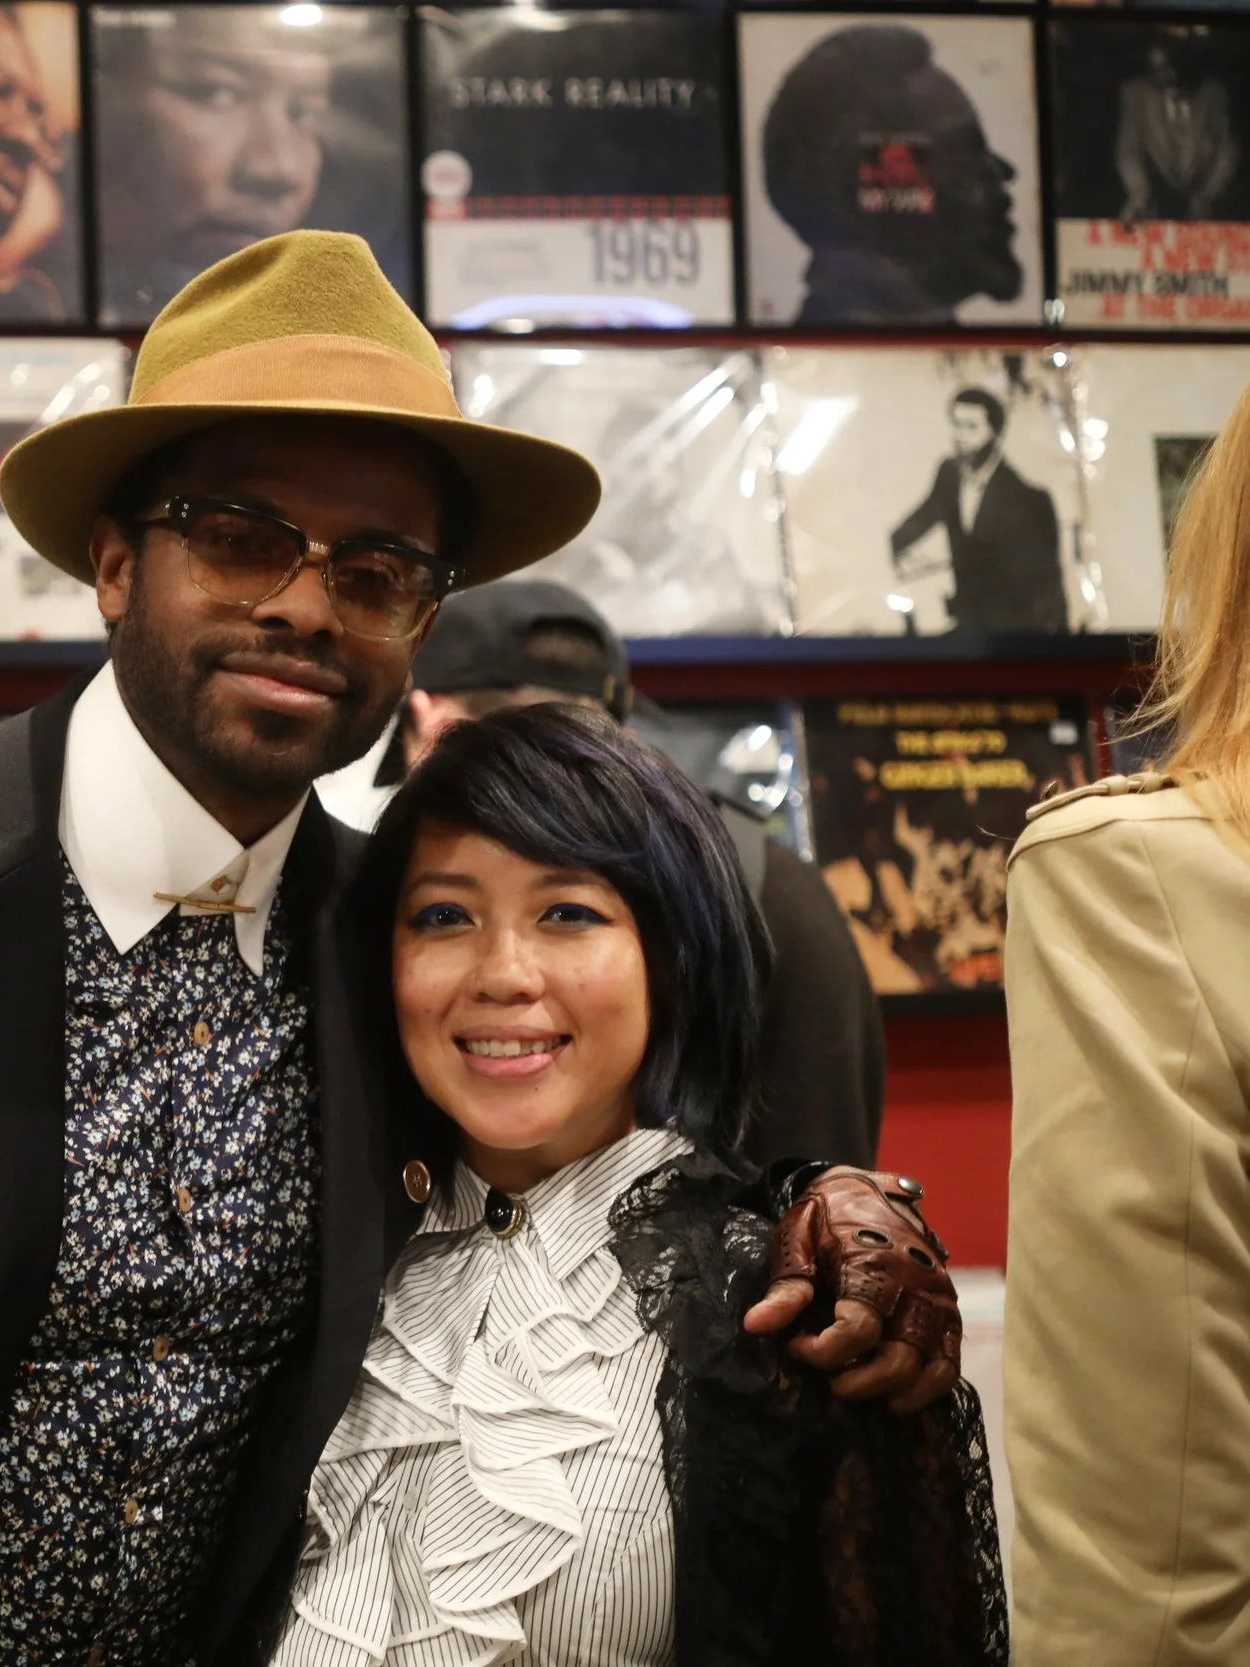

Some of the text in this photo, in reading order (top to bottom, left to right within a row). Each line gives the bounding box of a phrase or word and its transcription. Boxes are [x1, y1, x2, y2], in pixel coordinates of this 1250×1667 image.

[452, 77, 695, 110] STARK REALITY
[586, 217, 700, 288] 1969
[1064, 270, 1228, 298] JIMMY SMITH
